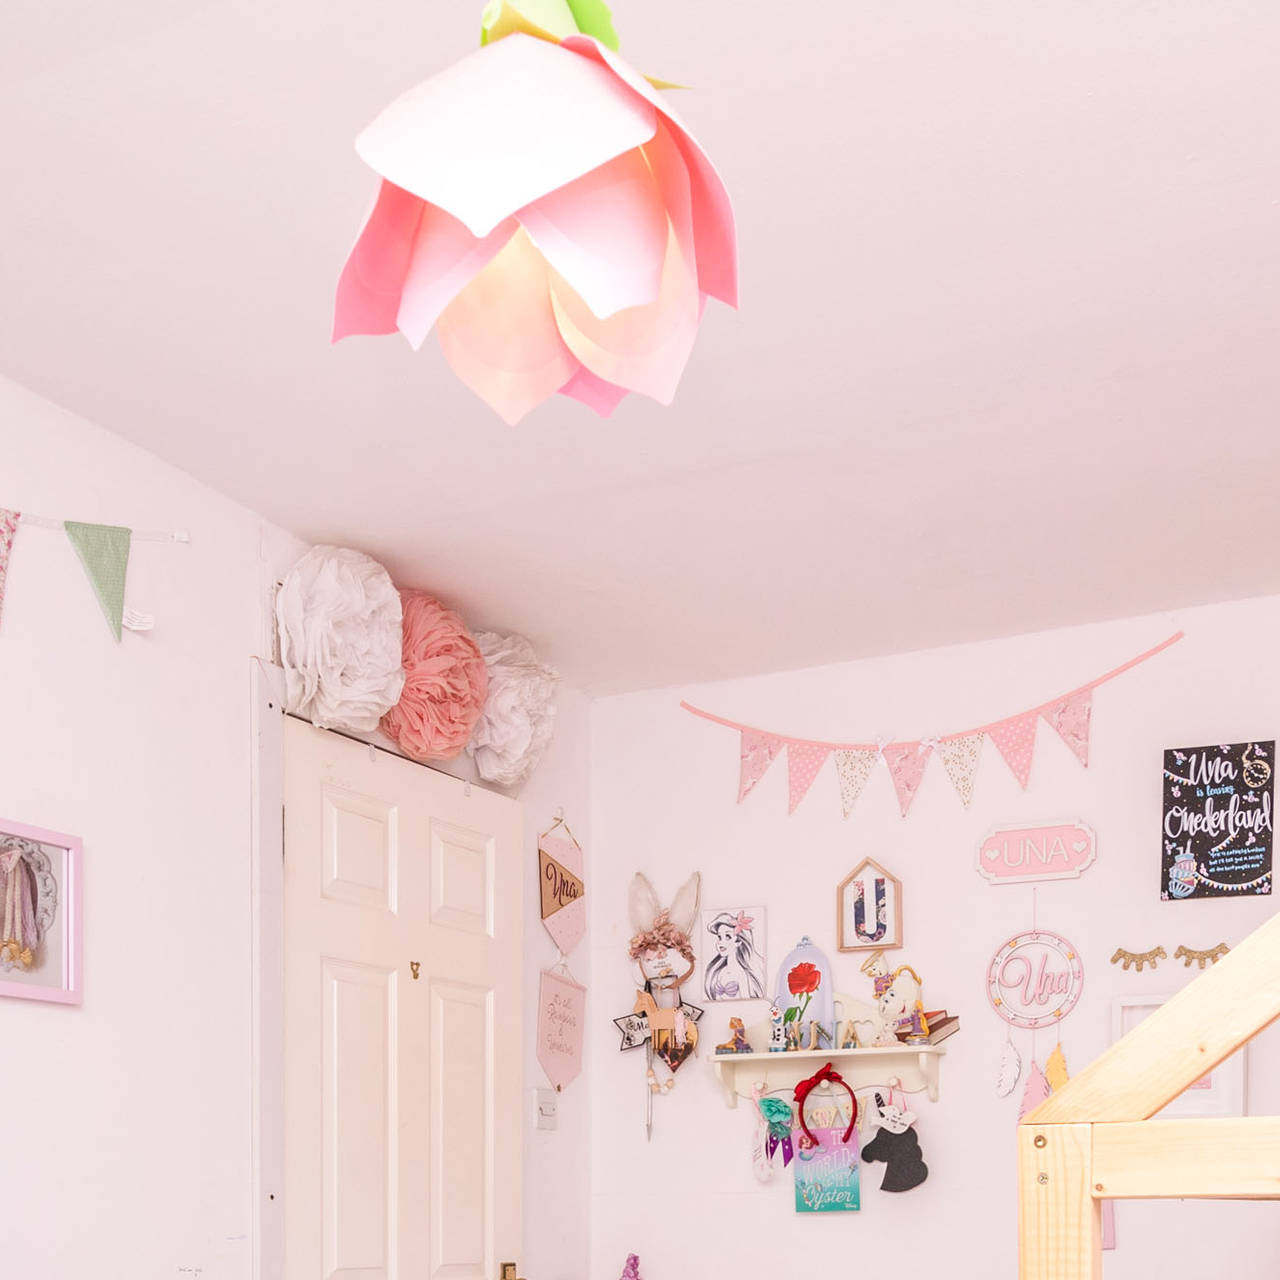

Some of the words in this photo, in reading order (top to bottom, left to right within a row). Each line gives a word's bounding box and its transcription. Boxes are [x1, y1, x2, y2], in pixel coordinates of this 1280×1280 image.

[1188, 751, 1239, 786] Una
[1195, 787, 1204, 798] is
[1164, 791, 1272, 838] Onederland
[1003, 836, 1069, 868] UNA
[546, 862, 579, 907] Una
[852, 877, 888, 943] U
[998, 952, 1070, 1006] Una
[806, 1184, 855, 1210] Oyster
